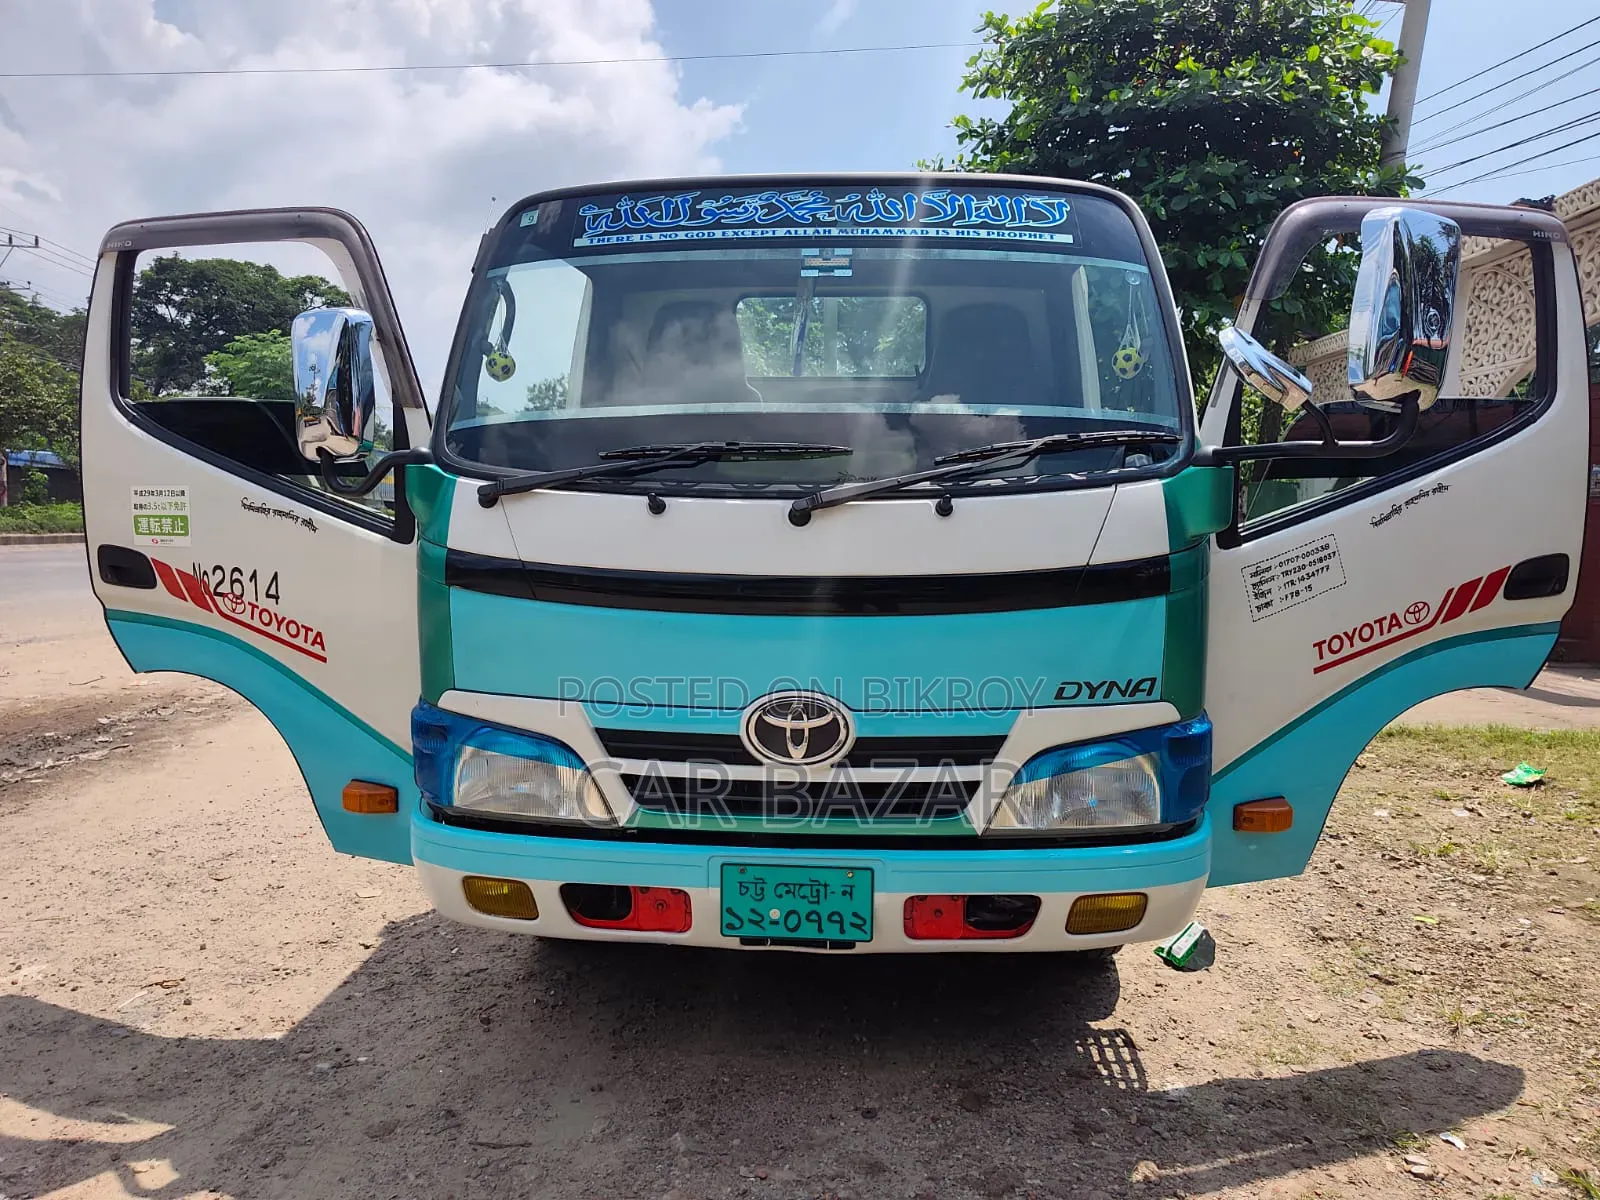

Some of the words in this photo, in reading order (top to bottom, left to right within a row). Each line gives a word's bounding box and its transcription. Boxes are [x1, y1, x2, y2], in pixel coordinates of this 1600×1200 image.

[587, 235, 634, 246] THERE
[639, 233, 653, 241] IS
[659, 231, 679, 240] NO
[685, 230, 716, 239] GOD
[721, 228, 778, 238] EXCEPT
[783, 227, 832, 237] ALLAH
[839, 227, 930, 237] MUHAMMAD
[935, 229, 952, 237] IS
[955, 229, 981, 238] HIS
[986, 230, 1057, 241] PROPHET
[137, 516, 186, 534] 運転禁止
[212, 564, 280, 606] 2614
[247, 601, 326, 652] TOYOTA
[1313, 612, 1403, 660] TOYOTA
[1053, 677, 1157, 700] DYNA
[737, 875, 767, 902] চট্ট
[725, 906, 869, 936] ১২-০৭৭২
